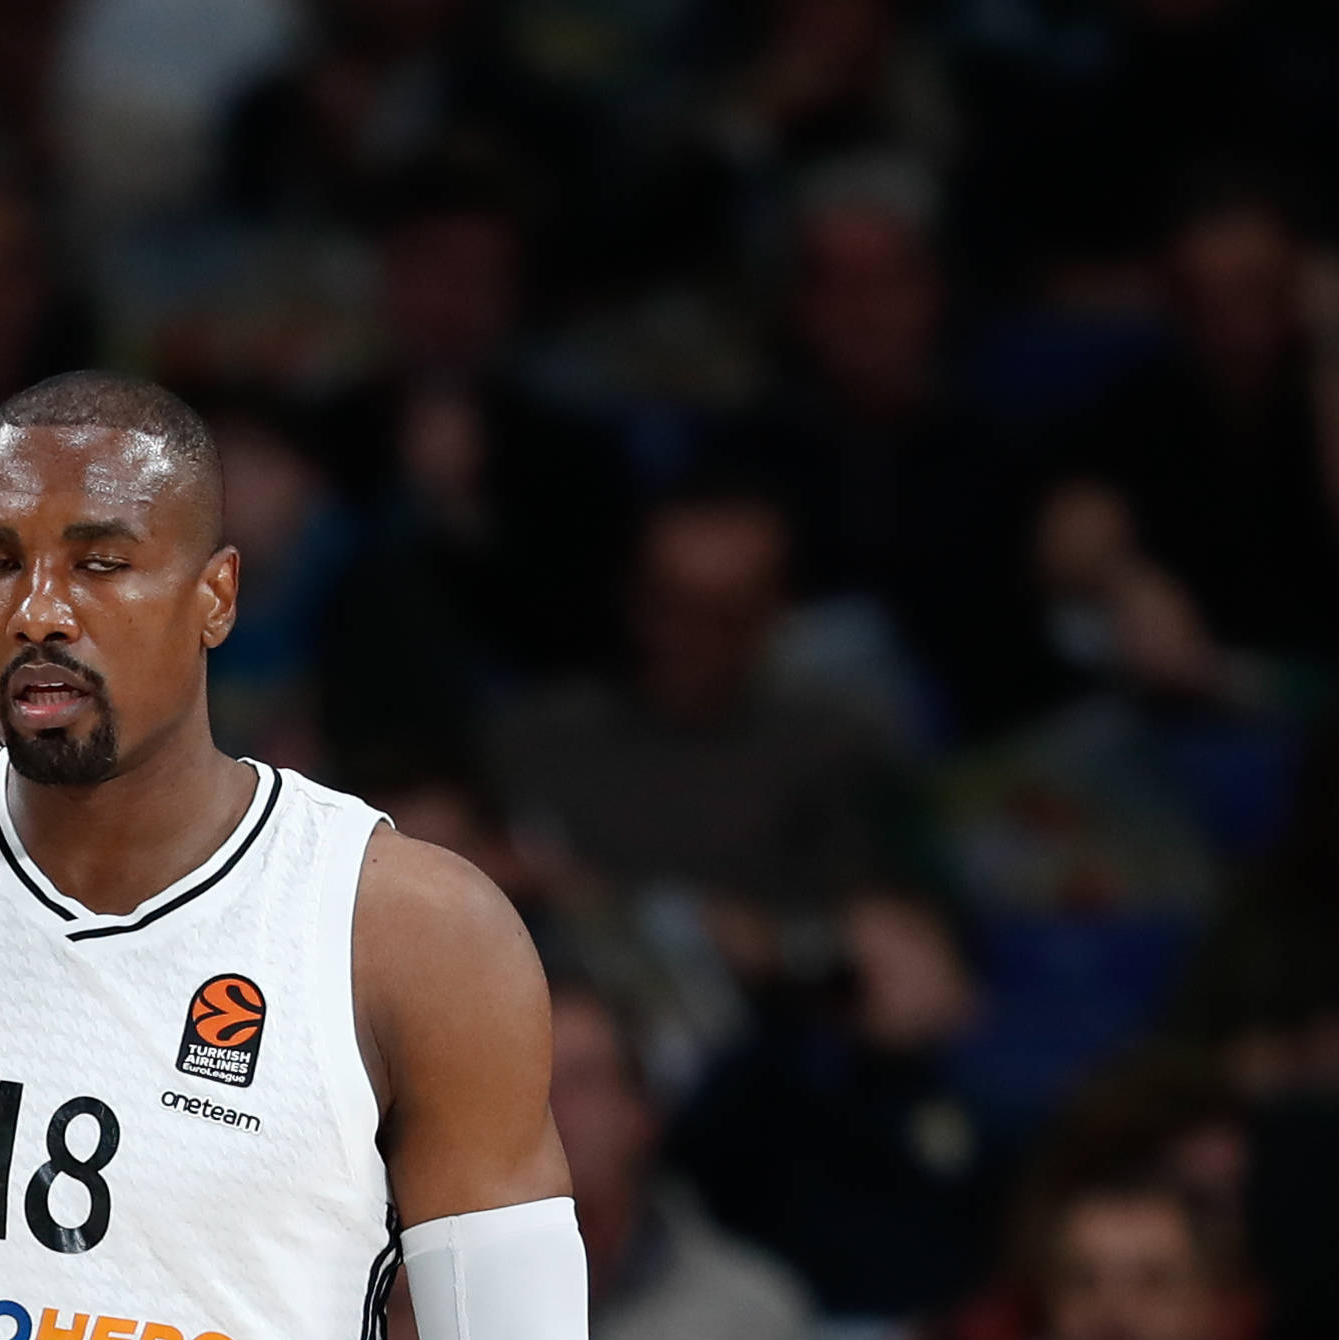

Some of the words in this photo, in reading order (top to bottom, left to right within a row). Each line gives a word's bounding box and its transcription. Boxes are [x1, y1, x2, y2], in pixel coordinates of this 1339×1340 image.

[188, 1044, 251, 1063] TURKISH
[182, 1063, 246, 1083] EuroLeague
[184, 1054, 249, 1074] AIRLINES
[161, 1091, 261, 1132] oneteam
